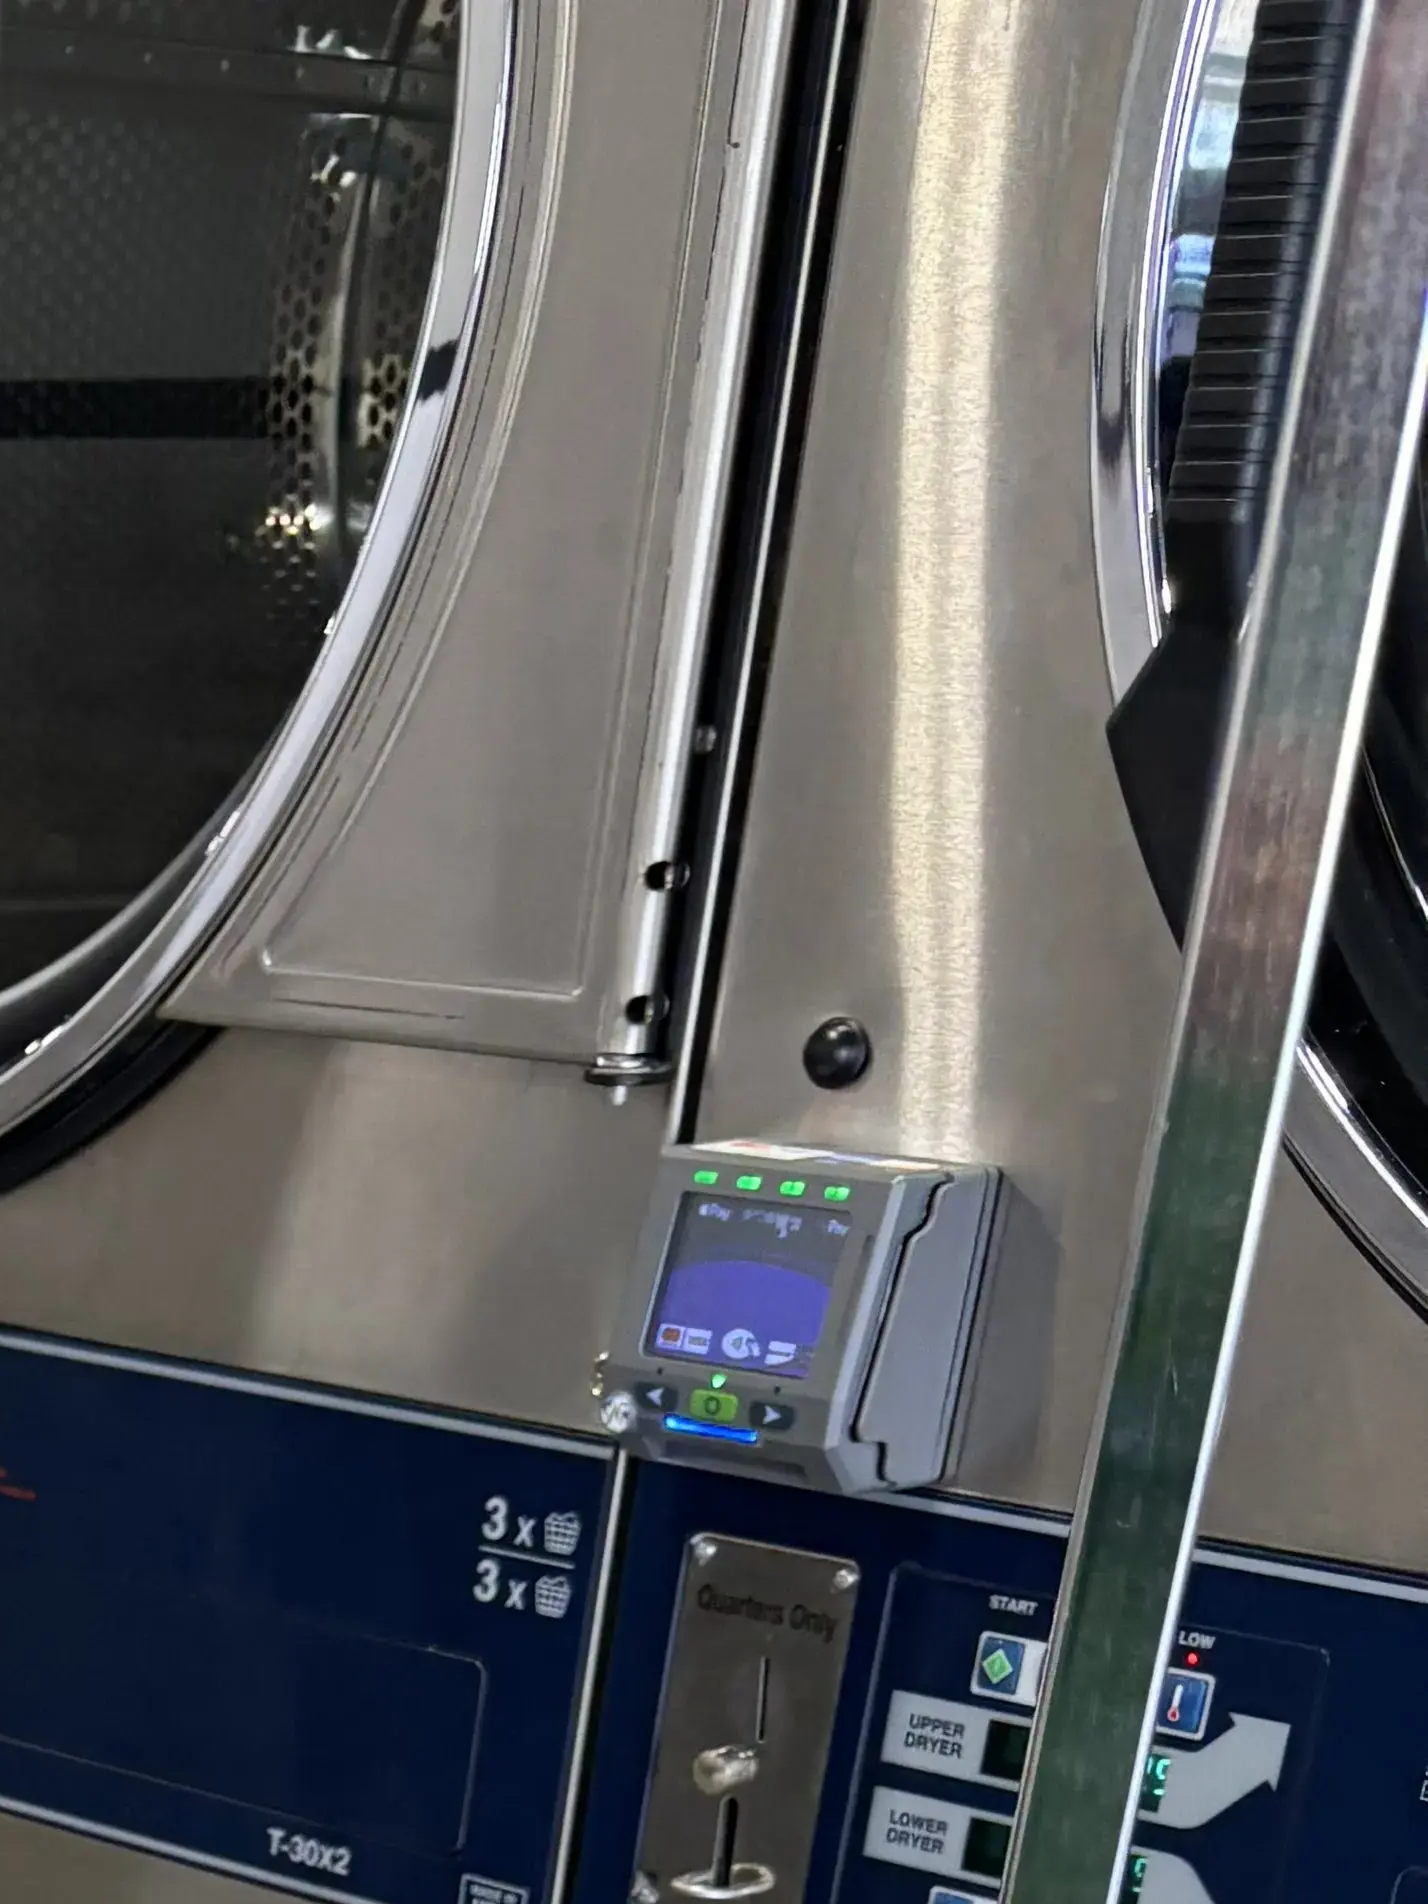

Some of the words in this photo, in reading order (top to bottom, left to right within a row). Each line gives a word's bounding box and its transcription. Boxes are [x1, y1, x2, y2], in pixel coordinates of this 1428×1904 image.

[481, 1496, 508, 1540] 3
[512, 1515, 537, 1547] x
[473, 1559, 499, 1602] 3
[504, 1579, 527, 1610] x
[988, 1594, 1038, 1616] START
[790, 1604, 838, 1644] Only
[1178, 1630, 1216, 1650] LOW
[909, 1713, 965, 1739] UPPER
[904, 1732, 963, 1759] DRYER
[889, 1809, 948, 1836] LOWER
[267, 1827, 352, 1876] T-30X2
[886, 1828, 944, 1854] DRYER
